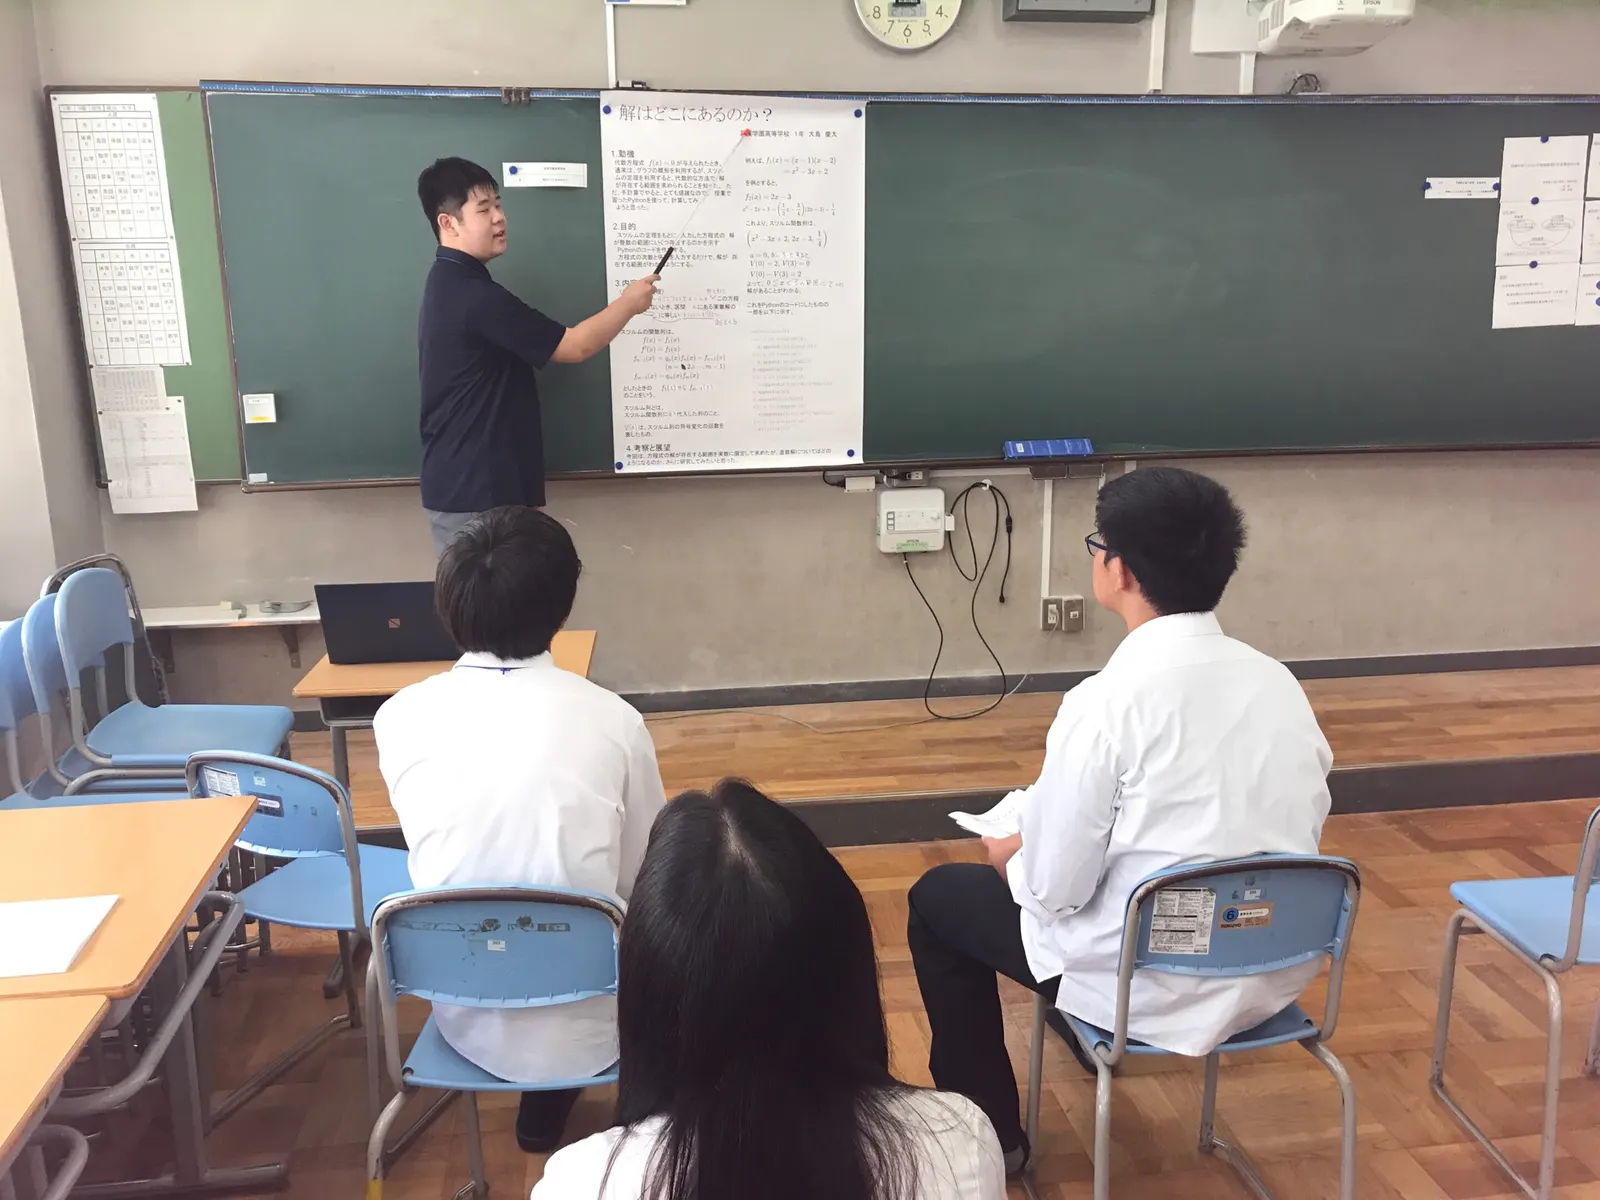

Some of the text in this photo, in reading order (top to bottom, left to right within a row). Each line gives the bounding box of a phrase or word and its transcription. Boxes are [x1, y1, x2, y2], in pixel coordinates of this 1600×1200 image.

[872, 6, 881, 19] 8
[936, 5, 943, 18] 4
[888, 20, 894, 33] 7
[903, 24, 912, 37] 6
[922, 20, 931, 33] 5
[1227, 910, 1235, 920] 6
